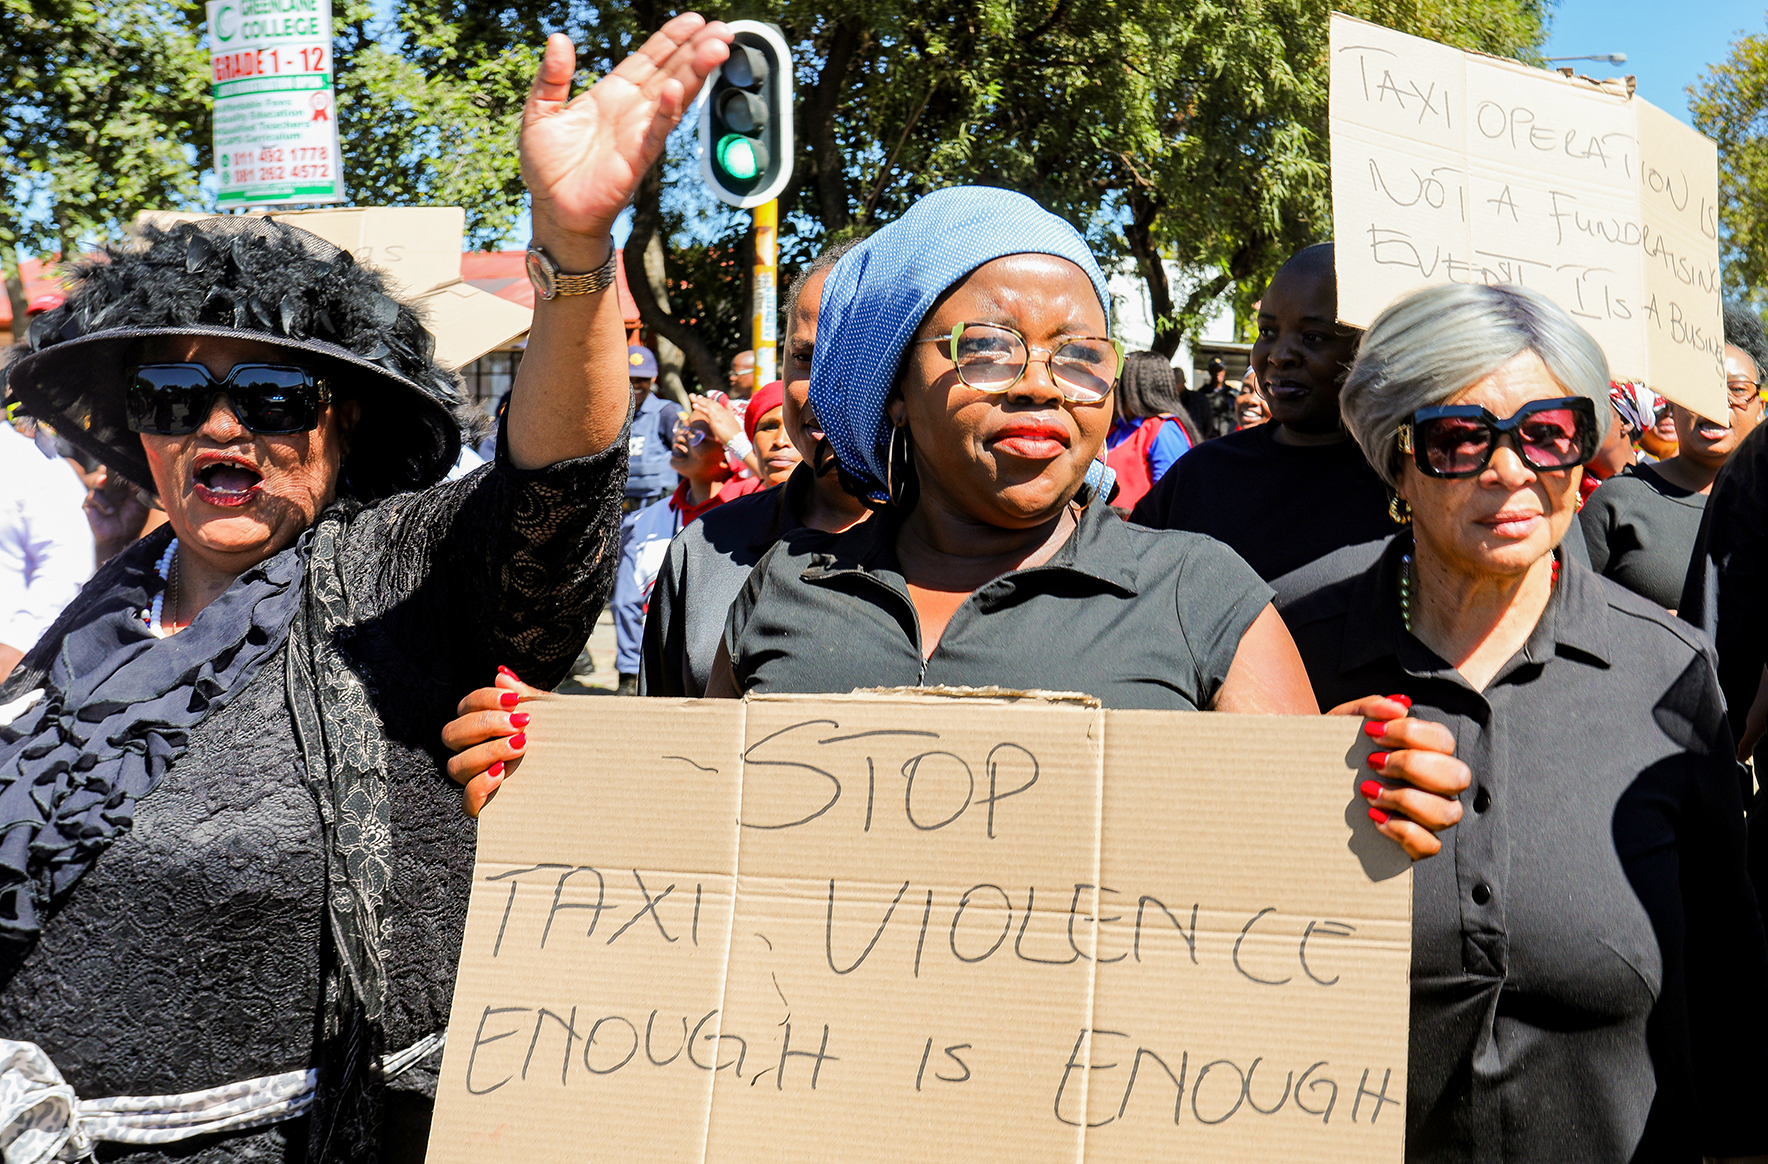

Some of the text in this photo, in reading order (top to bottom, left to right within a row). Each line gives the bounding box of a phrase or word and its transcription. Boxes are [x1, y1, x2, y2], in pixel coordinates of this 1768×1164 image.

[242, 17, 320, 39] COLLEGE
[214, 50, 265, 81] GRADE
[270, 49, 279, 73] 1
[300, 47, 325, 72] 12
[291, 146, 328, 161] 1778
[1338, 45, 1717, 240] TAXI OPERATION IS
[291, 164, 329, 179] 4572
[1368, 157, 1465, 223] NOT
[1486, 184, 1520, 223] A
[1644, 293, 1662, 330] A
[740, 719, 1040, 839] STOP
[485, 863, 1358, 986] TAXI VIOLENCE
[465, 1005, 1401, 1127] ENOUGH IS ENOUGH
